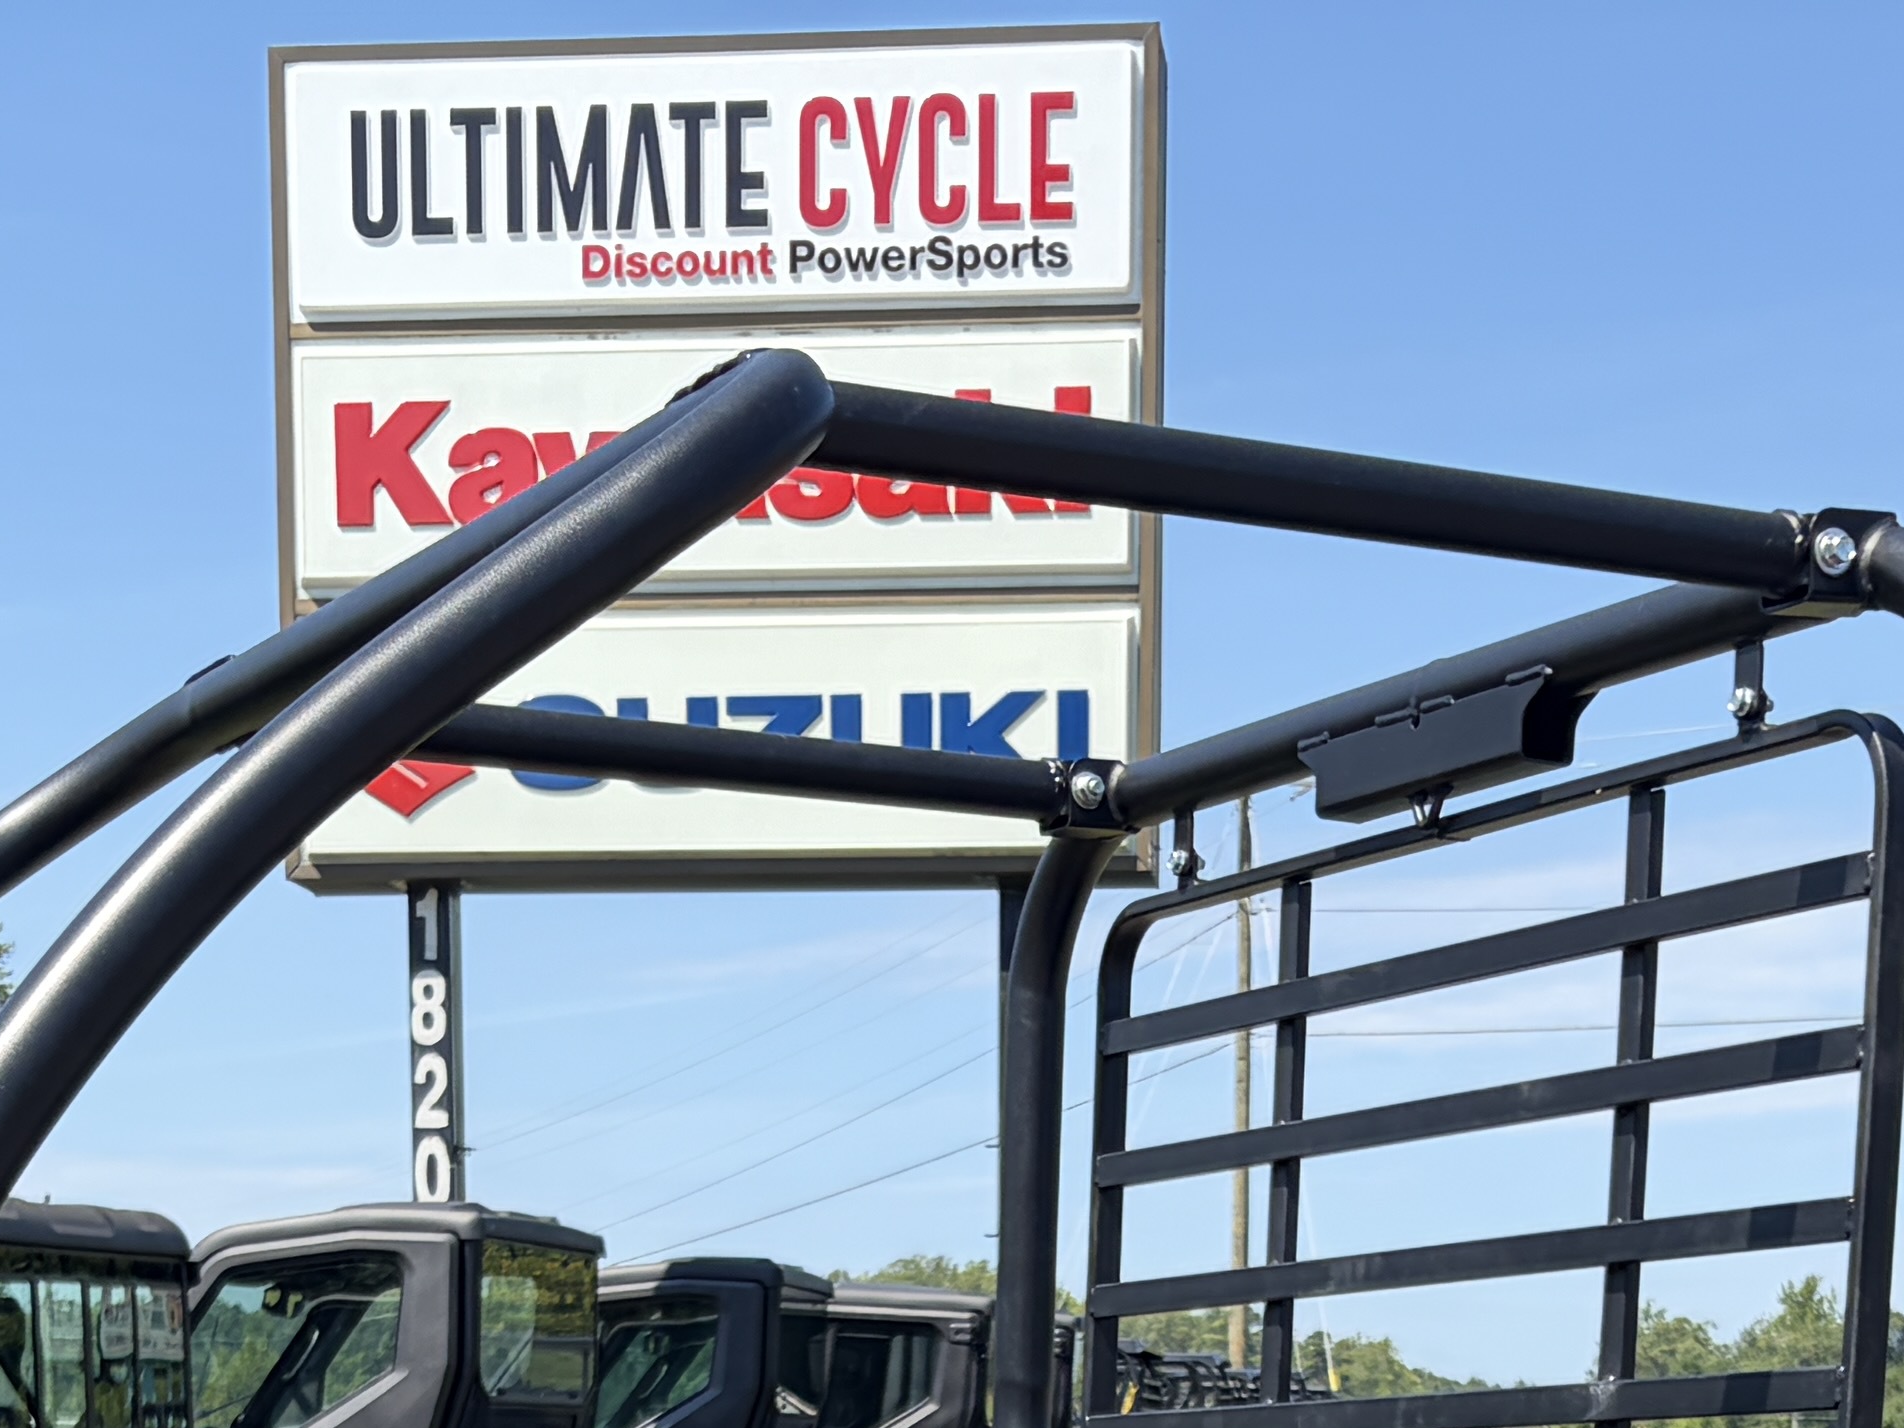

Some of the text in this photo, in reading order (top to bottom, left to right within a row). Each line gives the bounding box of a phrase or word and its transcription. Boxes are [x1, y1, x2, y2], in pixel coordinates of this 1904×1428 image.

[350, 90, 1076, 240] ULTIMATE CYCLE
[582, 236, 1070, 281] Discount PowerSports
[334, 386, 1092, 528] Kasa
[511, 690, 1089, 791] ZUKI
[411, 887, 451, 1203] 1820
